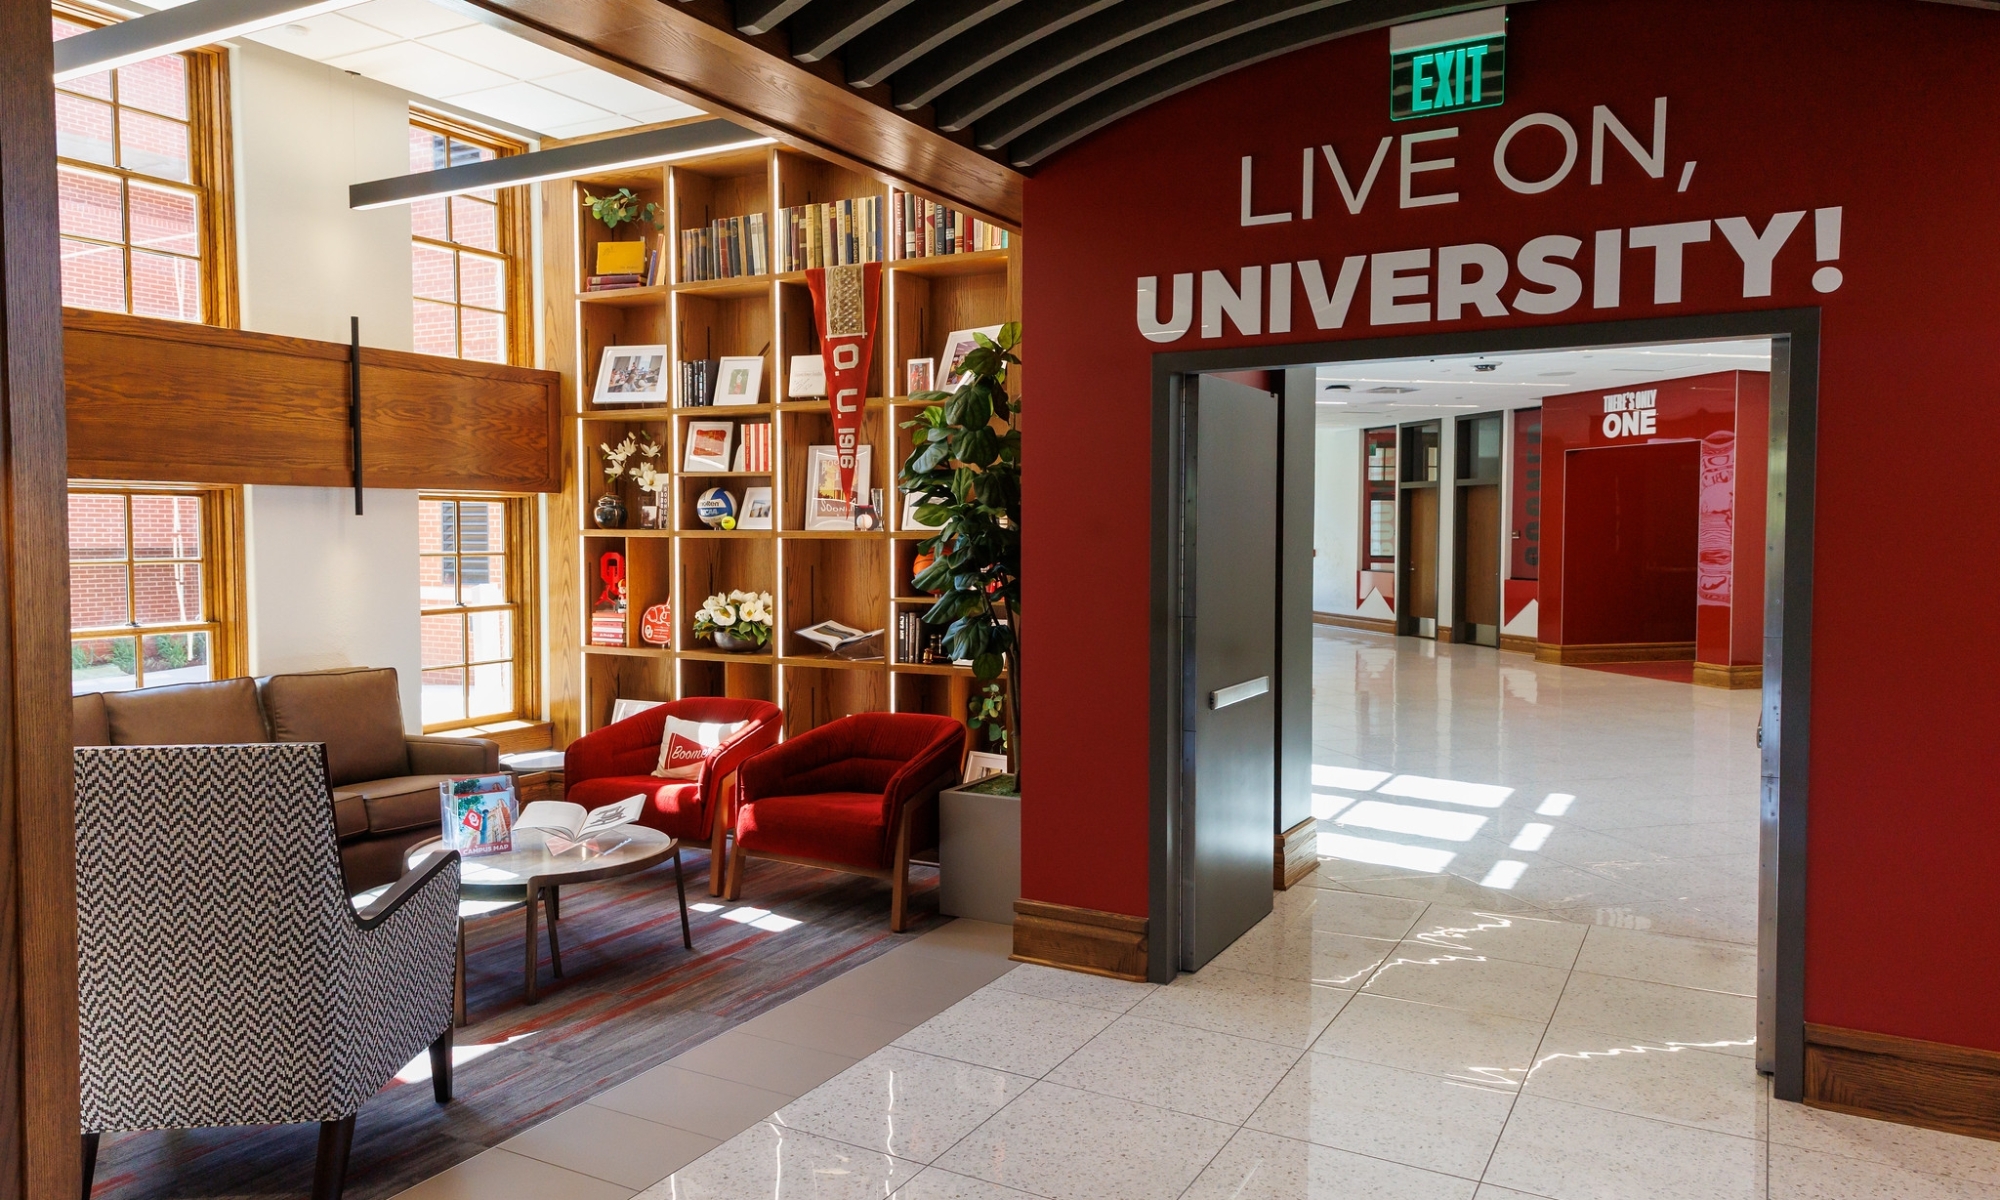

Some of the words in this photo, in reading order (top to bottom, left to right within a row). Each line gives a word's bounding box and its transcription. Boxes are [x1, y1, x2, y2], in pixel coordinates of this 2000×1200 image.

[1412, 44, 1489, 113] EXIT
[1240, 127, 1459, 226] LIVE
[1493, 97, 1698, 194] ON,
[1137, 206, 1843, 343] UNIVERSITY!
[1602, 409, 1657, 439] ONE
[1603, 391, 1635, 413] THERE'S
[1635, 389, 1658, 409] ONLY
[462, 845, 492, 855] CAMPUS
[493, 844, 509, 852] MAP
